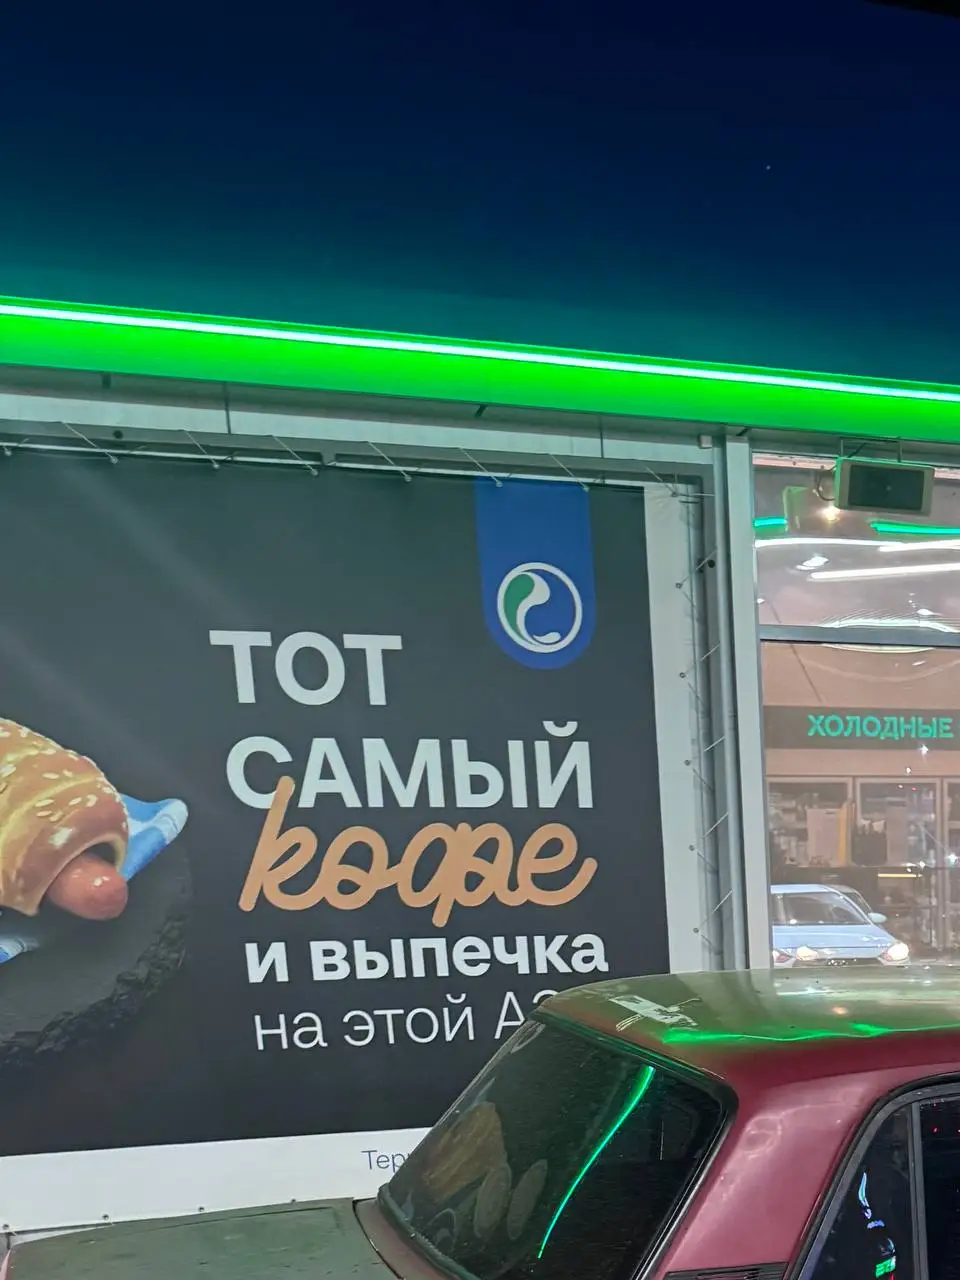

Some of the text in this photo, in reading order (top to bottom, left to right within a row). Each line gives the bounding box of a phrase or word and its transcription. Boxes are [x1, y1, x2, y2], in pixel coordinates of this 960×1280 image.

[209, 630, 403, 706] ТОТ
[807, 714, 953, 741] ХОЛОДНЫЕ
[226, 721, 593, 810] САМЫЙ
[238, 775, 598, 928] кофе
[245, 932, 610, 984] и выпечка
[254, 1009, 329, 1051] на
[343, 992, 476, 1047] этой
[360, 1149, 410, 1174] Тер
